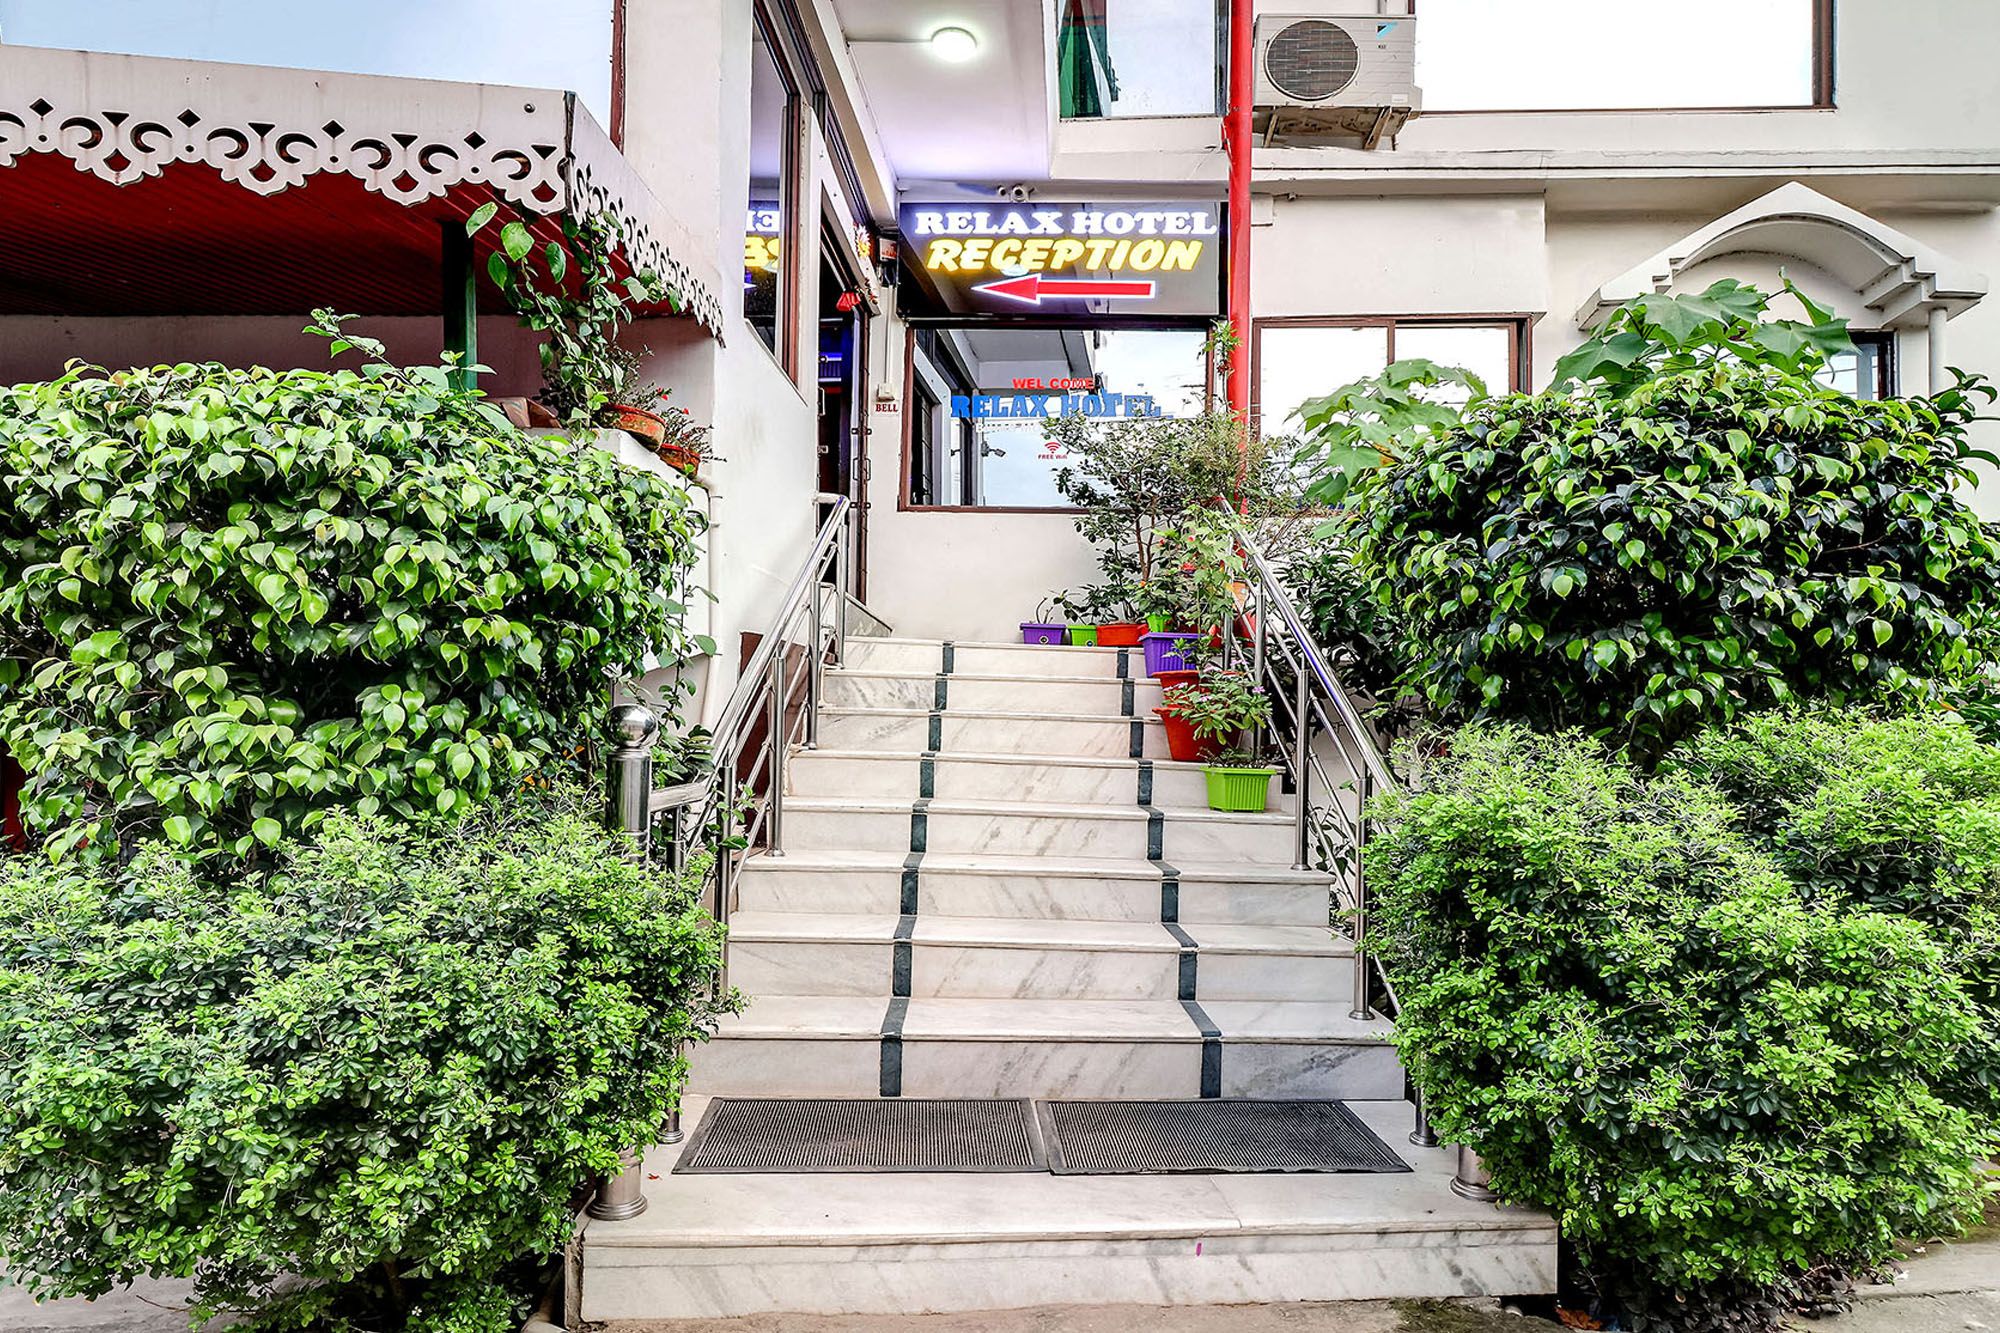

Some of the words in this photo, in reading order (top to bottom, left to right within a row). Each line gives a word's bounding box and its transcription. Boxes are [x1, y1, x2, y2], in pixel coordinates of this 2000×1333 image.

[914, 211, 1065, 235] RELAX
[1071, 211, 1218, 235] HOTEL
[927, 237, 1203, 272] RECEPTION
[875, 403, 899, 413] BELL
[951, 394, 1049, 418] RELAX
[1060, 392, 1162, 418] HOTEL
